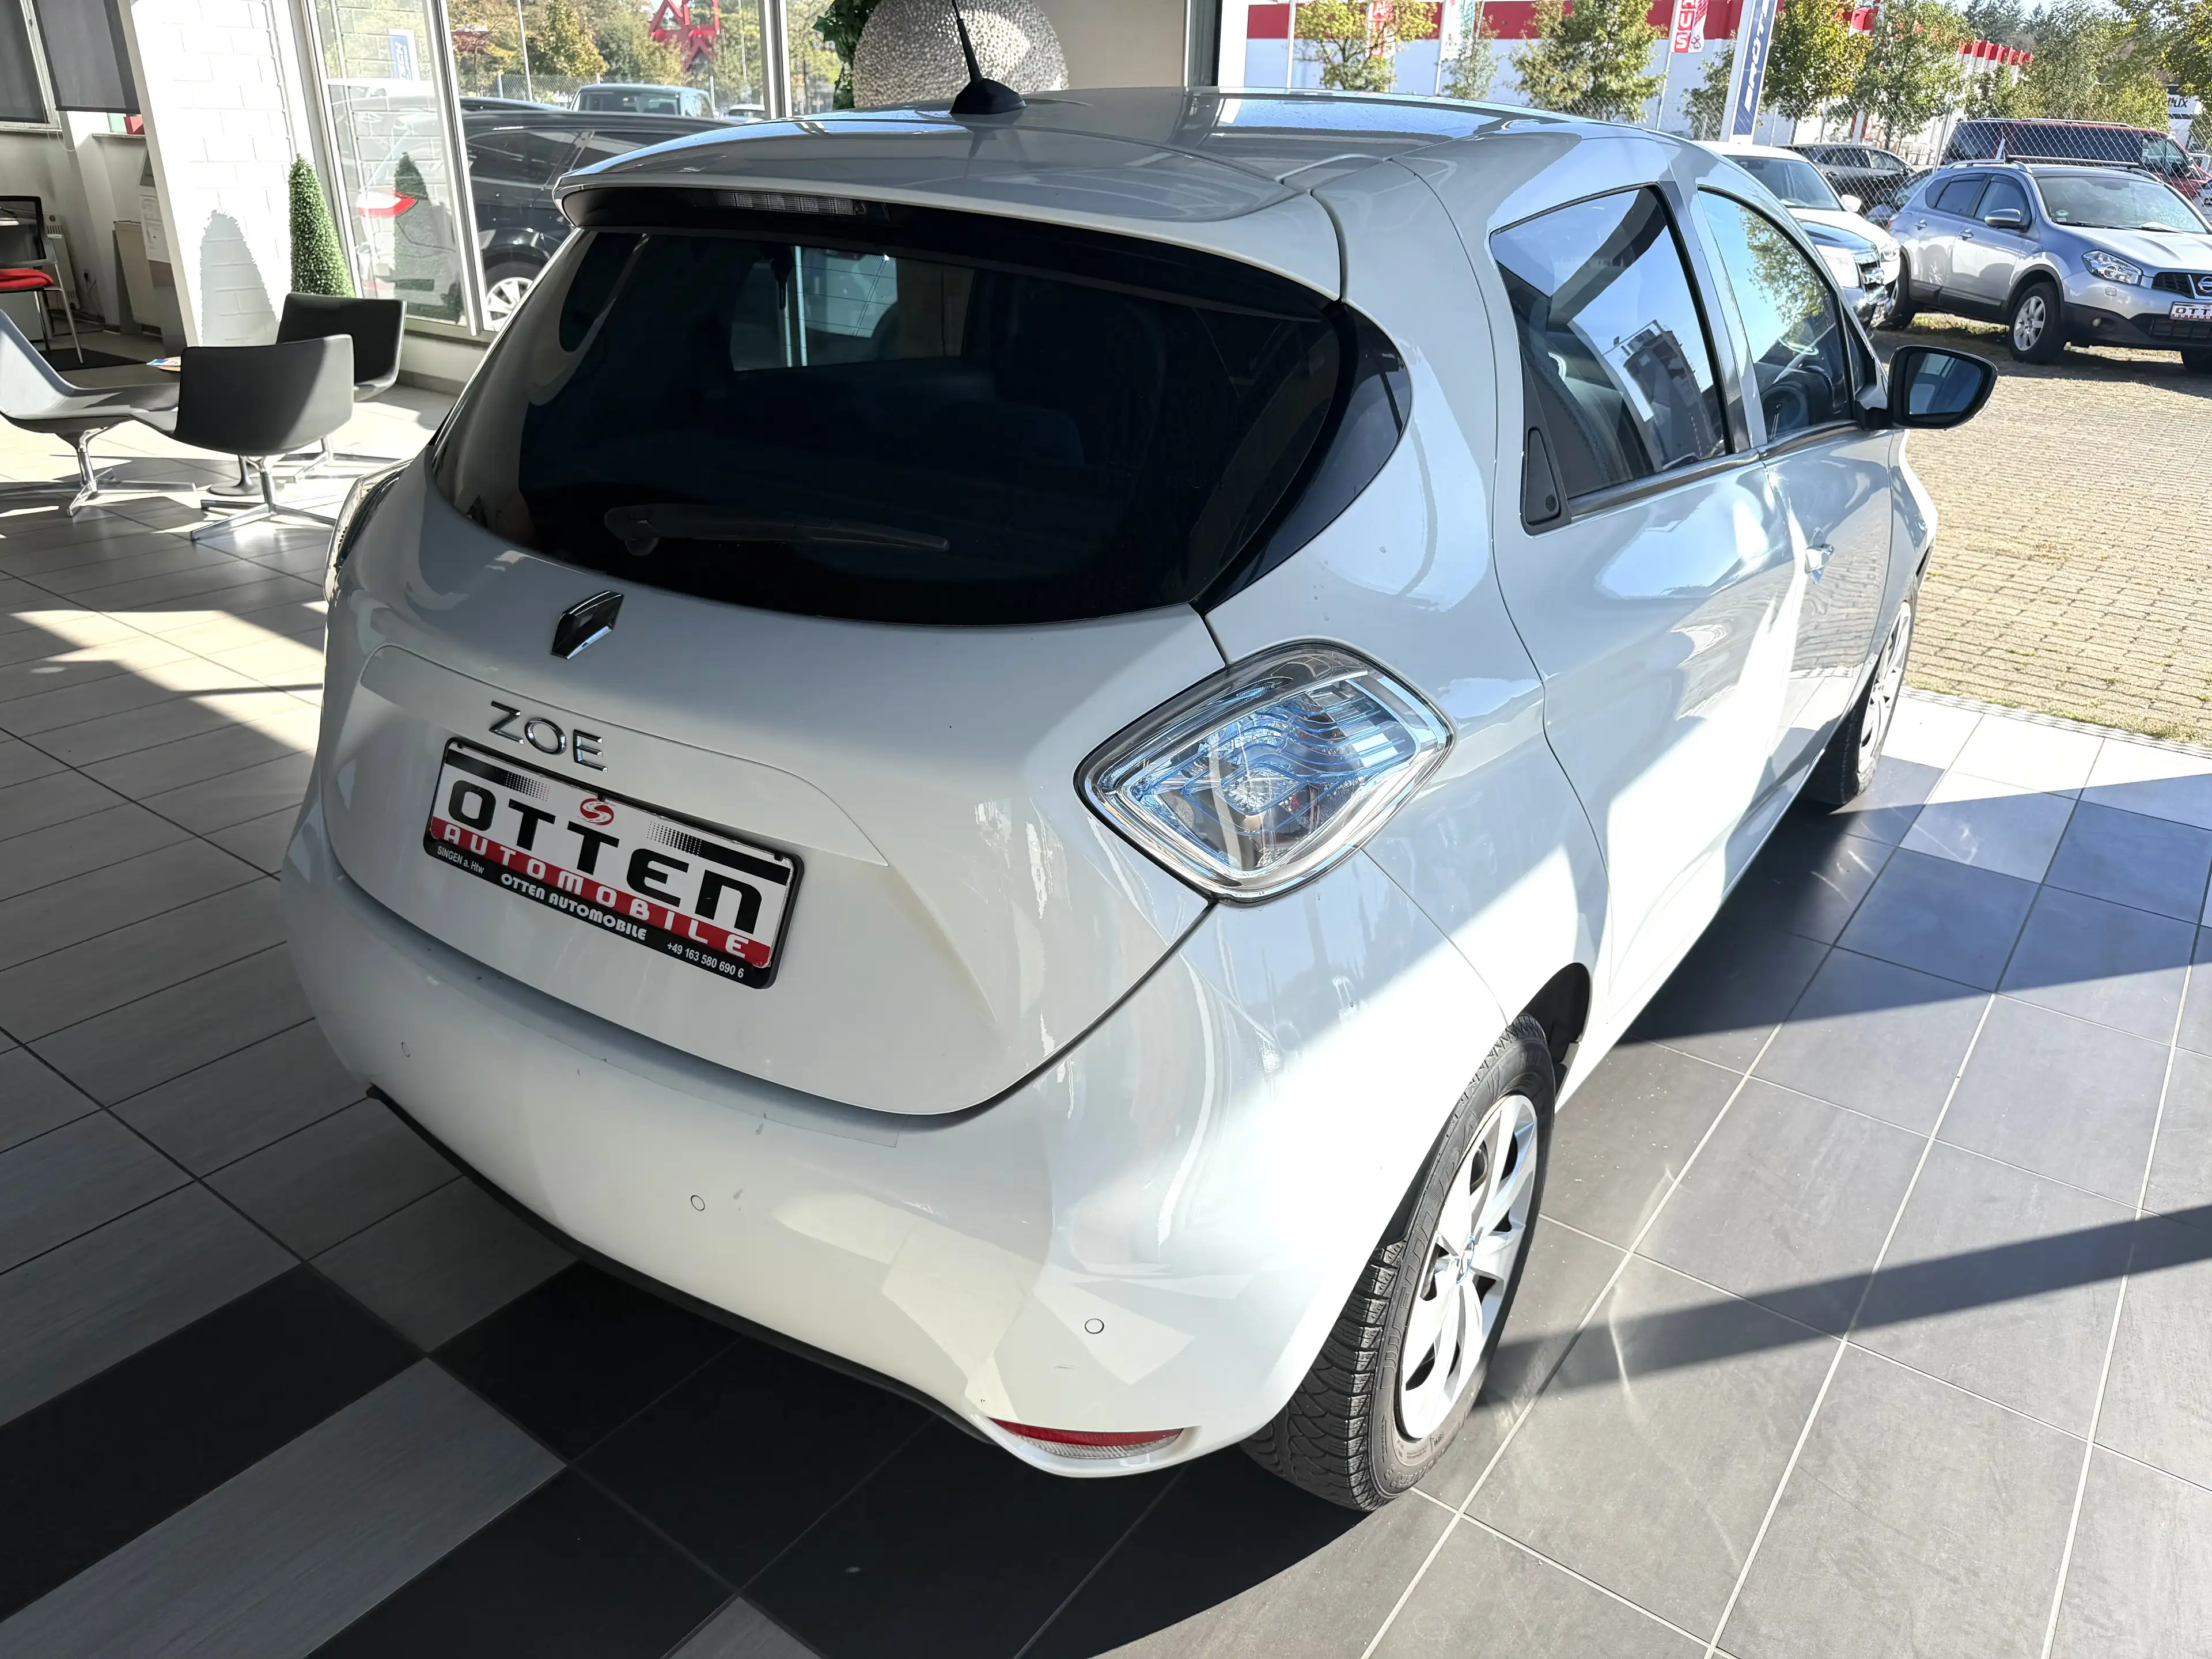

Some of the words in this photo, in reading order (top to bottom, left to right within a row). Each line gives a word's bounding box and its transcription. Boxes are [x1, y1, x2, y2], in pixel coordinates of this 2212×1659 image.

[489, 700, 608, 773] ZOE
[437, 846, 463, 865] SINGEN
[448, 780, 762, 934] OTTEN
[444, 824, 749, 959] AUTOMOBILE
[501, 873, 546, 900] OTTEN
[549, 893, 647, 941] AUTOMOBILE
[667, 942, 683, 955] +49
[685, 948, 700, 961] 163
[700, 954, 718, 968] 580
[719, 961, 736, 975] 690
[737, 968, 745, 978] 6
